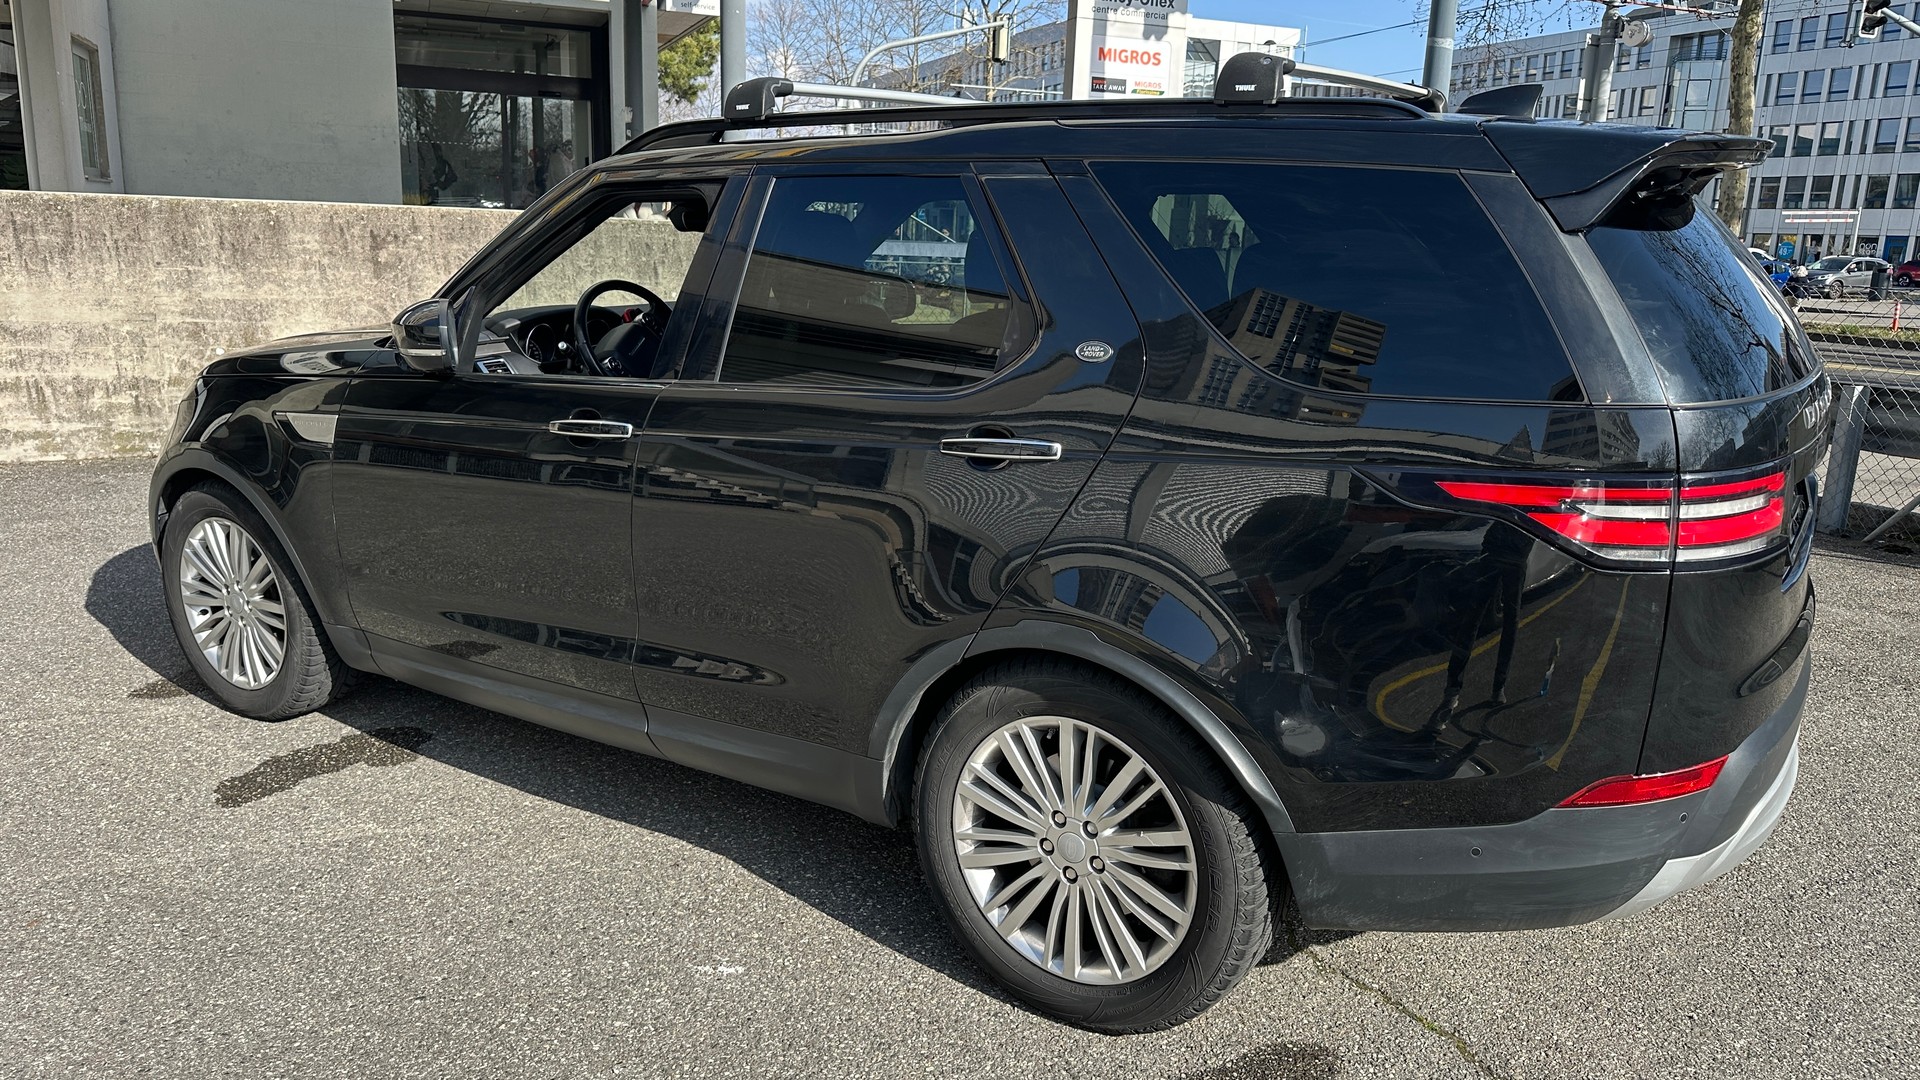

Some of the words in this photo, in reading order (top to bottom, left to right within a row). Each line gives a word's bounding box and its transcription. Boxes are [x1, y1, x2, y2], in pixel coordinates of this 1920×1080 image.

[1091, 6, 1118, 15] centre
[1120, 9, 1169, 20] commercial
[1098, 46, 1162, 67] MIGROS
[1092, 83, 1107, 91] TAKE
[1108, 84, 1126, 92] AWAY
[1134, 81, 1162, 90] MIGROS
[1234, 84, 1257, 92] THULE
[1190, 803, 1224, 934] COOPER
